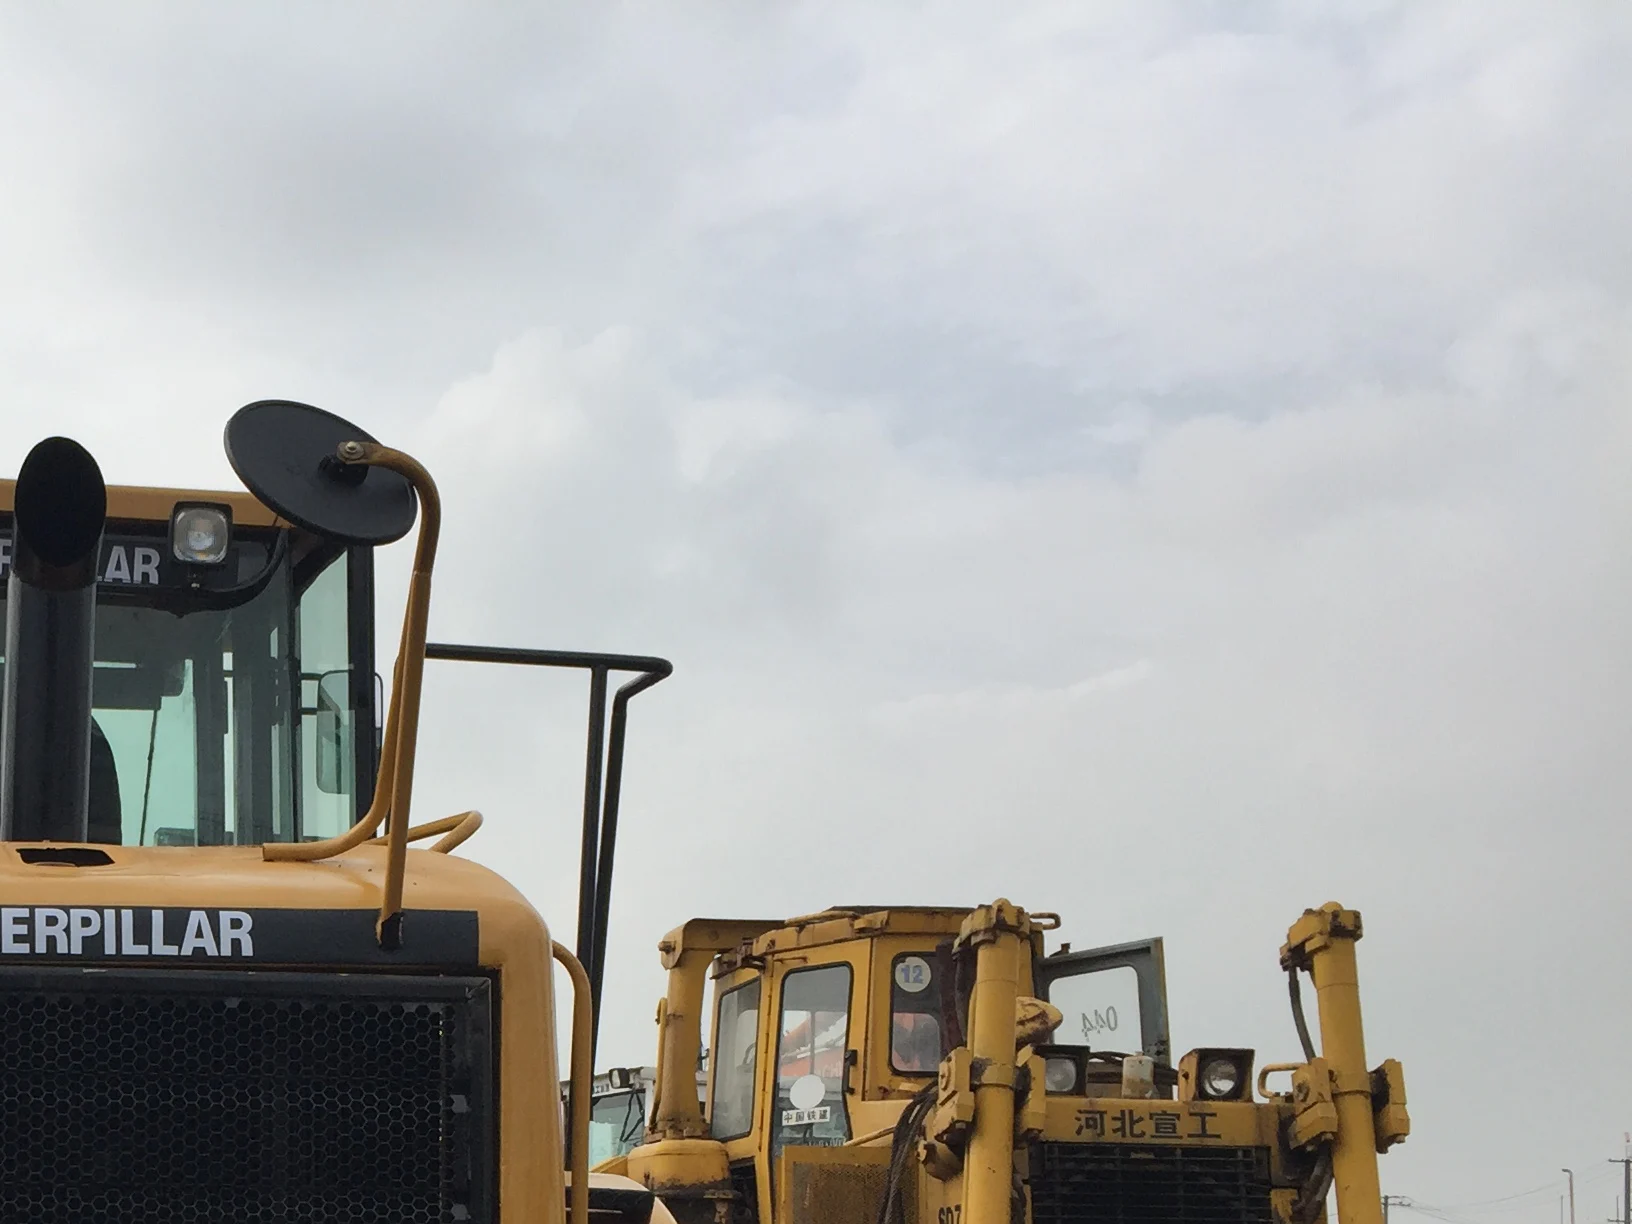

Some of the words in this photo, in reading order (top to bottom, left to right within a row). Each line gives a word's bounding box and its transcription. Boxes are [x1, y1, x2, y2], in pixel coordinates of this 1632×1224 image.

[901, 964, 924, 984] 12
[1074, 1109, 1222, 1140] 河北宣工
